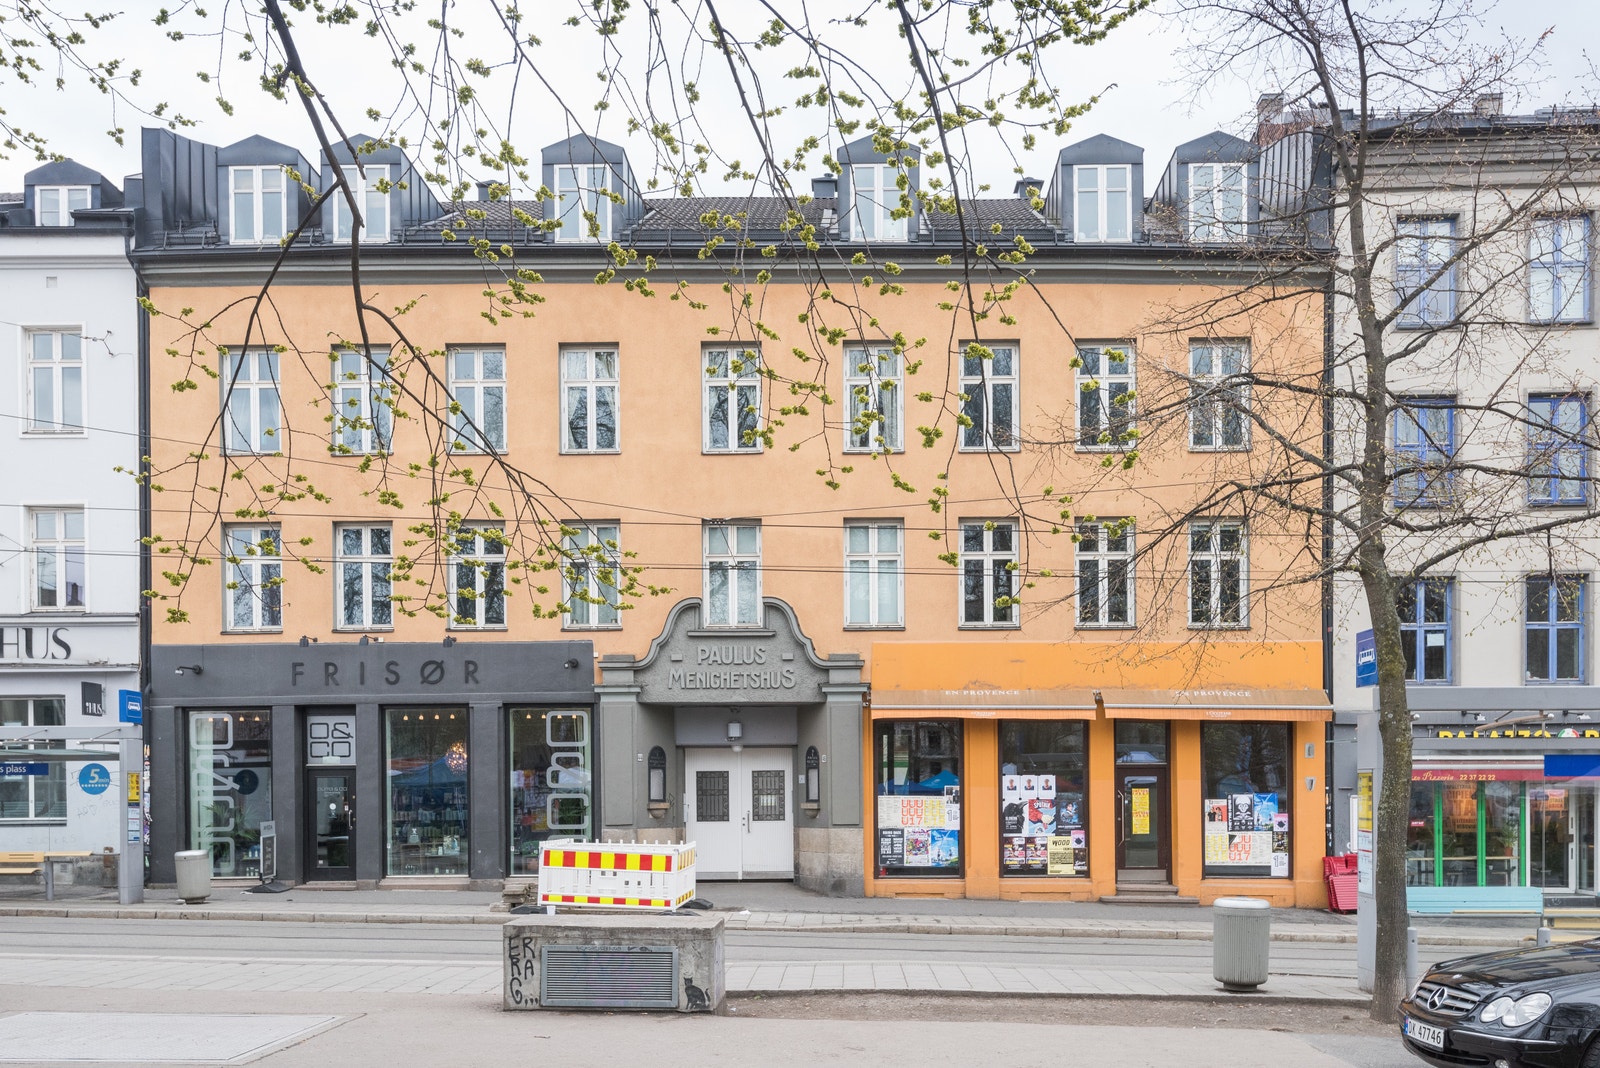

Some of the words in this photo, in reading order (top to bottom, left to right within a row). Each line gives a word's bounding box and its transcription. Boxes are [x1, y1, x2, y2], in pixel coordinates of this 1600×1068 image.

[697, 645, 766, 665] PAULUS
[291, 660, 479, 686] FRISØR
[667, 667, 796, 690] MENIGHETSHUS
[5, 764, 27, 775] plass
[88, 768, 100, 784] 5
[1418, 1025, 1441, 1045] 47746
